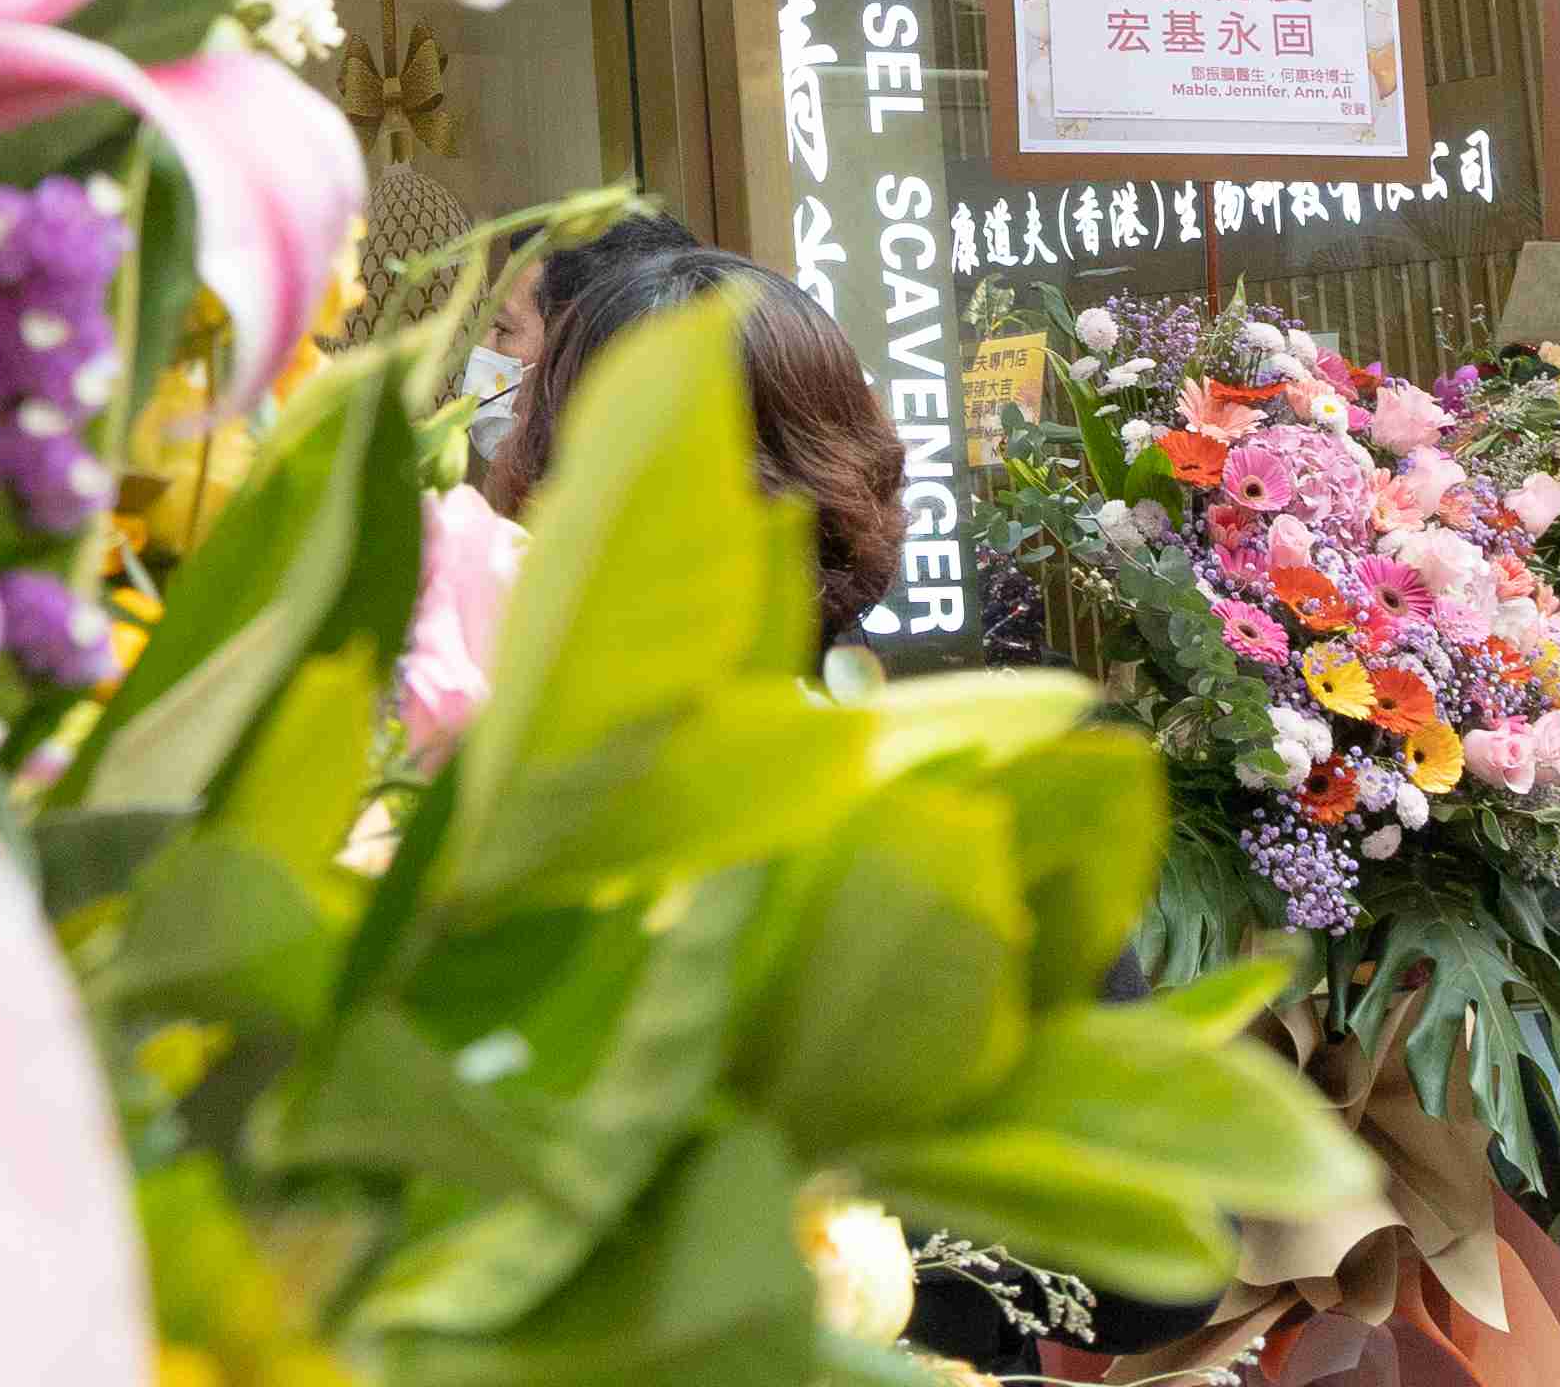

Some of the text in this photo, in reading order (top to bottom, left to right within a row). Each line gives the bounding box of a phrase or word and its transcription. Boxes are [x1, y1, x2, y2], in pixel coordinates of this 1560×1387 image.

[1107, 9, 1315, 57] 宏基永固
[1171, 83, 1221, 97] Mable,
[1224, 85, 1290, 99] Jennifer,
[875, 172, 966, 636] SCAVENGER
